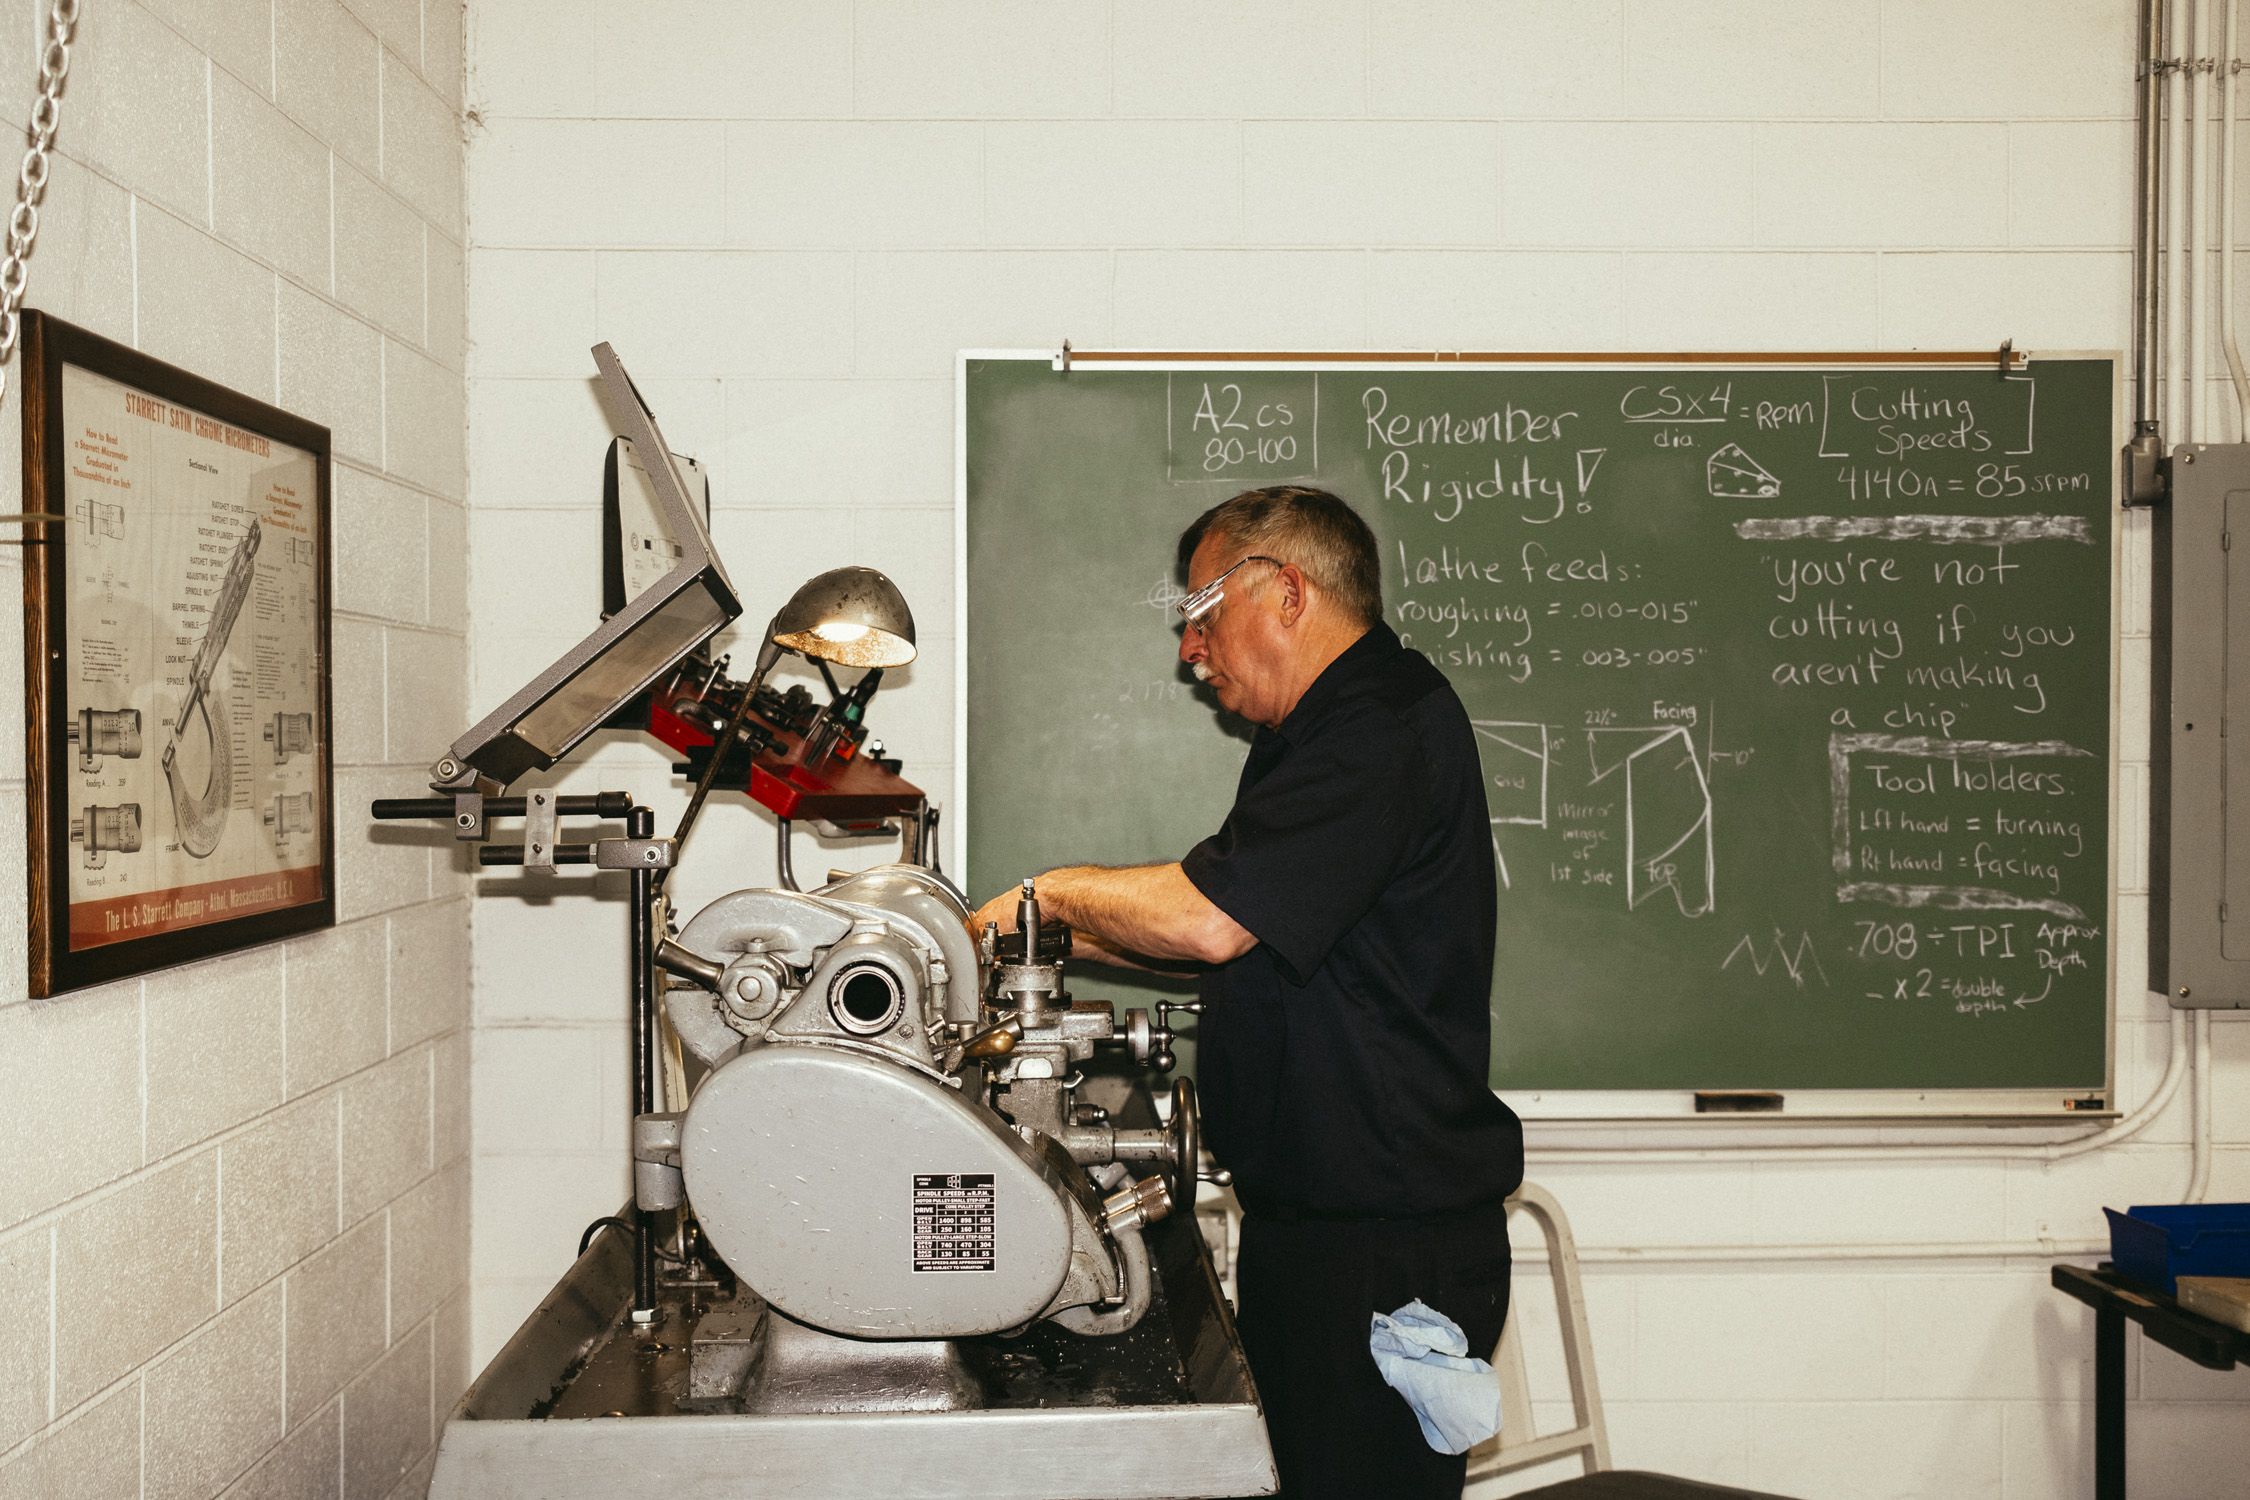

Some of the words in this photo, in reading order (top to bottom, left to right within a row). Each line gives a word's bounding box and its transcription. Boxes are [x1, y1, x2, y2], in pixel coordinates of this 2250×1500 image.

[125, 391, 166, 425] STARRETT
[170, 407, 192, 433] SATIN
[195, 416, 223, 443] CHROME
[225, 426, 271, 458] MICROMETERS
[1193, 383, 1248, 433] A2
[1363, 388, 1579, 448] Remember
[1851, 386, 1974, 431] Cutting
[80, 440, 99, 454] Starrett
[101, 446, 129, 461] Micrometer
[86, 427, 97, 439] How
[99, 432, 105, 441] to
[105, 433, 118, 445] Read
[1203, 436, 1297, 471] 80-100
[1876, 425, 1992, 460] Speeds
[73, 466, 106, 483] Thousandths
[106, 475, 112, 484] of
[113, 479, 120, 487] an
[121, 477, 131, 489] Inch
[86, 455, 112, 471] Graduated
[114, 463, 119, 472] in
[188, 458, 208, 472] Sectional
[208, 464, 219, 475] View
[1382, 449, 1607, 523] Rigidity!
[1399, 540, 1502, 588] lathe
[1521, 541, 1642, 584] feeds:
[1934, 546, 2020, 585] not
[185, 586, 202, 597] SPINDLE
[1397, 597, 1532, 647] roughing
[1769, 600, 1903, 659] cutting
[1937, 604, 1976, 644] if
[2000, 624, 2075, 657] you
[166, 677, 185, 686] SPINDLE
[1771, 652, 1885, 686] aren't
[1906, 656, 2046, 714] making
[1653, 700, 1697, 727] Facing
[1829, 708, 1857, 728] a
[1866, 764, 1935, 793] Tool
[1901, 811, 1949, 833] hand
[1995, 808, 2083, 858] turning
[1889, 849, 1943, 872] hand
[1974, 842, 2060, 896] facing
[106, 909, 120, 933] The
[123, 907, 131, 930] L.
[133, 905, 140, 927] S.
[143, 901, 172, 926] Starrett
[175, 897, 205, 921] Company
[1950, 923, 2016, 957] TPI
[2036, 922, 2100, 947] Approx
[914, 1206, 934, 1214] DRIVE
